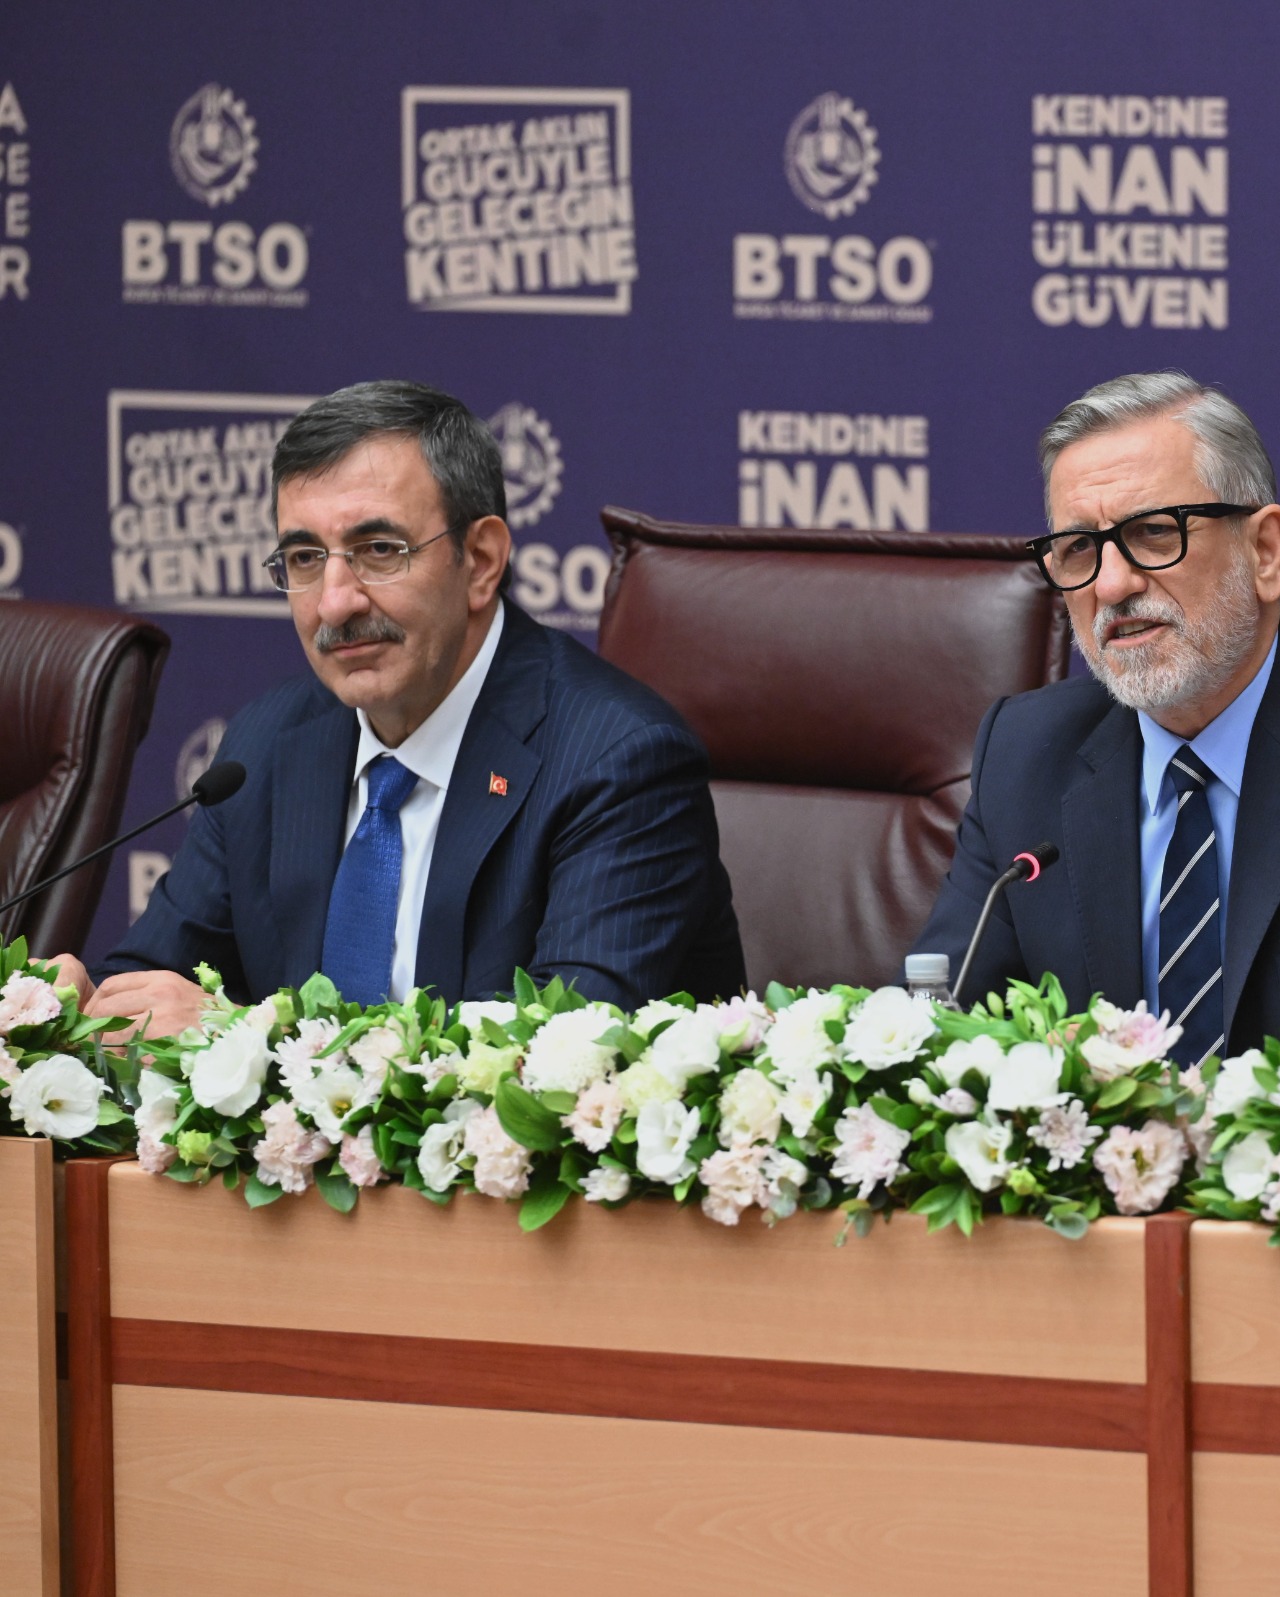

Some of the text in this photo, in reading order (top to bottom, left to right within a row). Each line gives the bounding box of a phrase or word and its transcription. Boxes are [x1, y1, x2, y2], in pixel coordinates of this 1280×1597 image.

[123, 222, 308, 287] BTSO
[734, 234, 932, 302] BTSO
[1032, 221, 1228, 270] ÜLKENE
[1032, 273, 1228, 330] GÜVEN
[111, 541, 278, 604] KENTİ
[509, 543, 611, 613] SO
